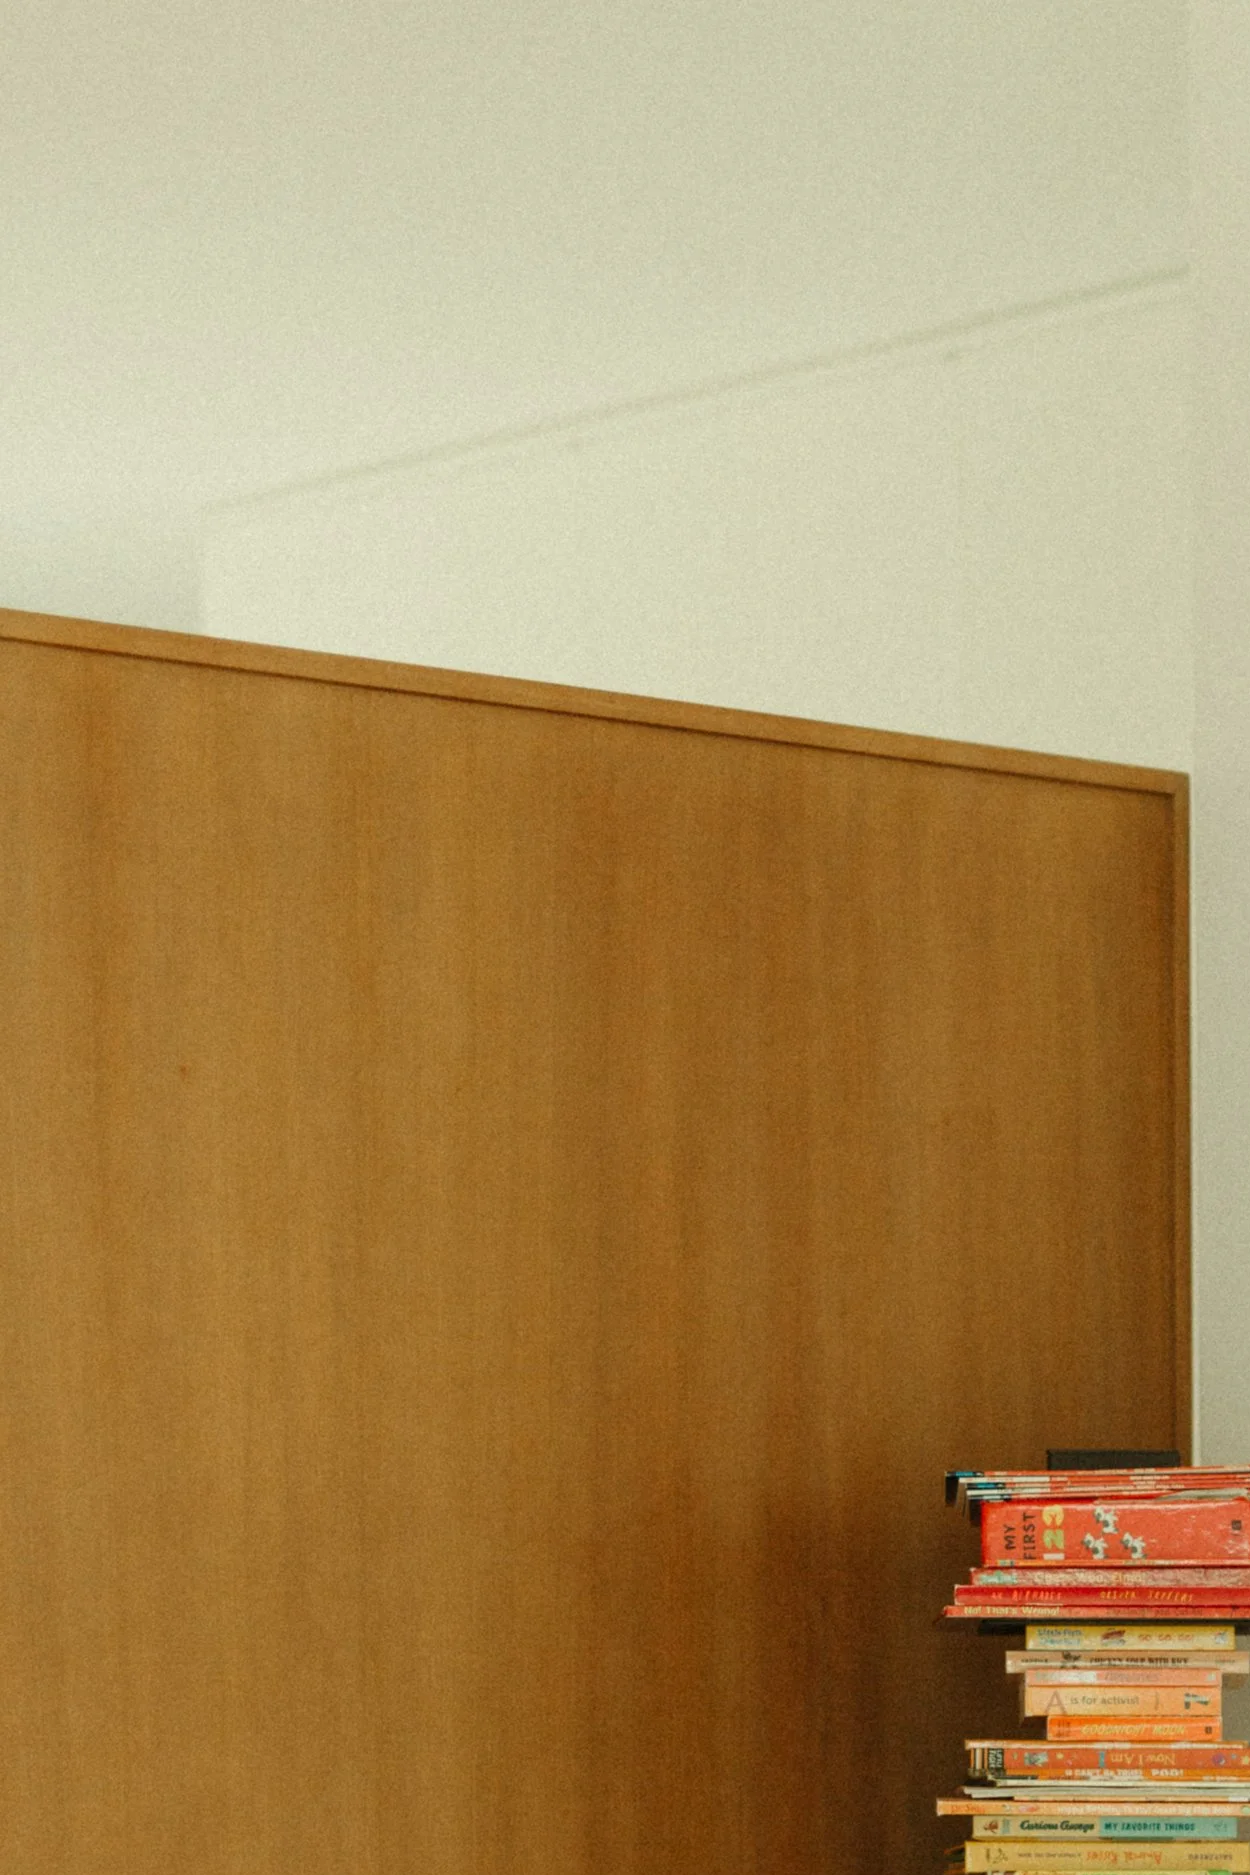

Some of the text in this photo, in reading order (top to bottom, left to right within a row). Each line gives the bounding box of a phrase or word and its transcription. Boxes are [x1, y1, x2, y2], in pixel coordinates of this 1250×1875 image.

[1004, 1524, 1017, 1550] MY
[1023, 1512, 1037, 1560] FIRST
[1044, 1691, 1140, 1715] A is for activist
[1081, 1725, 1185, 1735] GOODNIGHT MOON
[1111, 1751, 1135, 1763] Am
[1148, 1751, 1176, 1765] Now
[1020, 1821, 1095, 1833] Curious George
[1121, 1822, 1161, 1831] FAVORITE
[1164, 1823, 1195, 1831] THINGS
